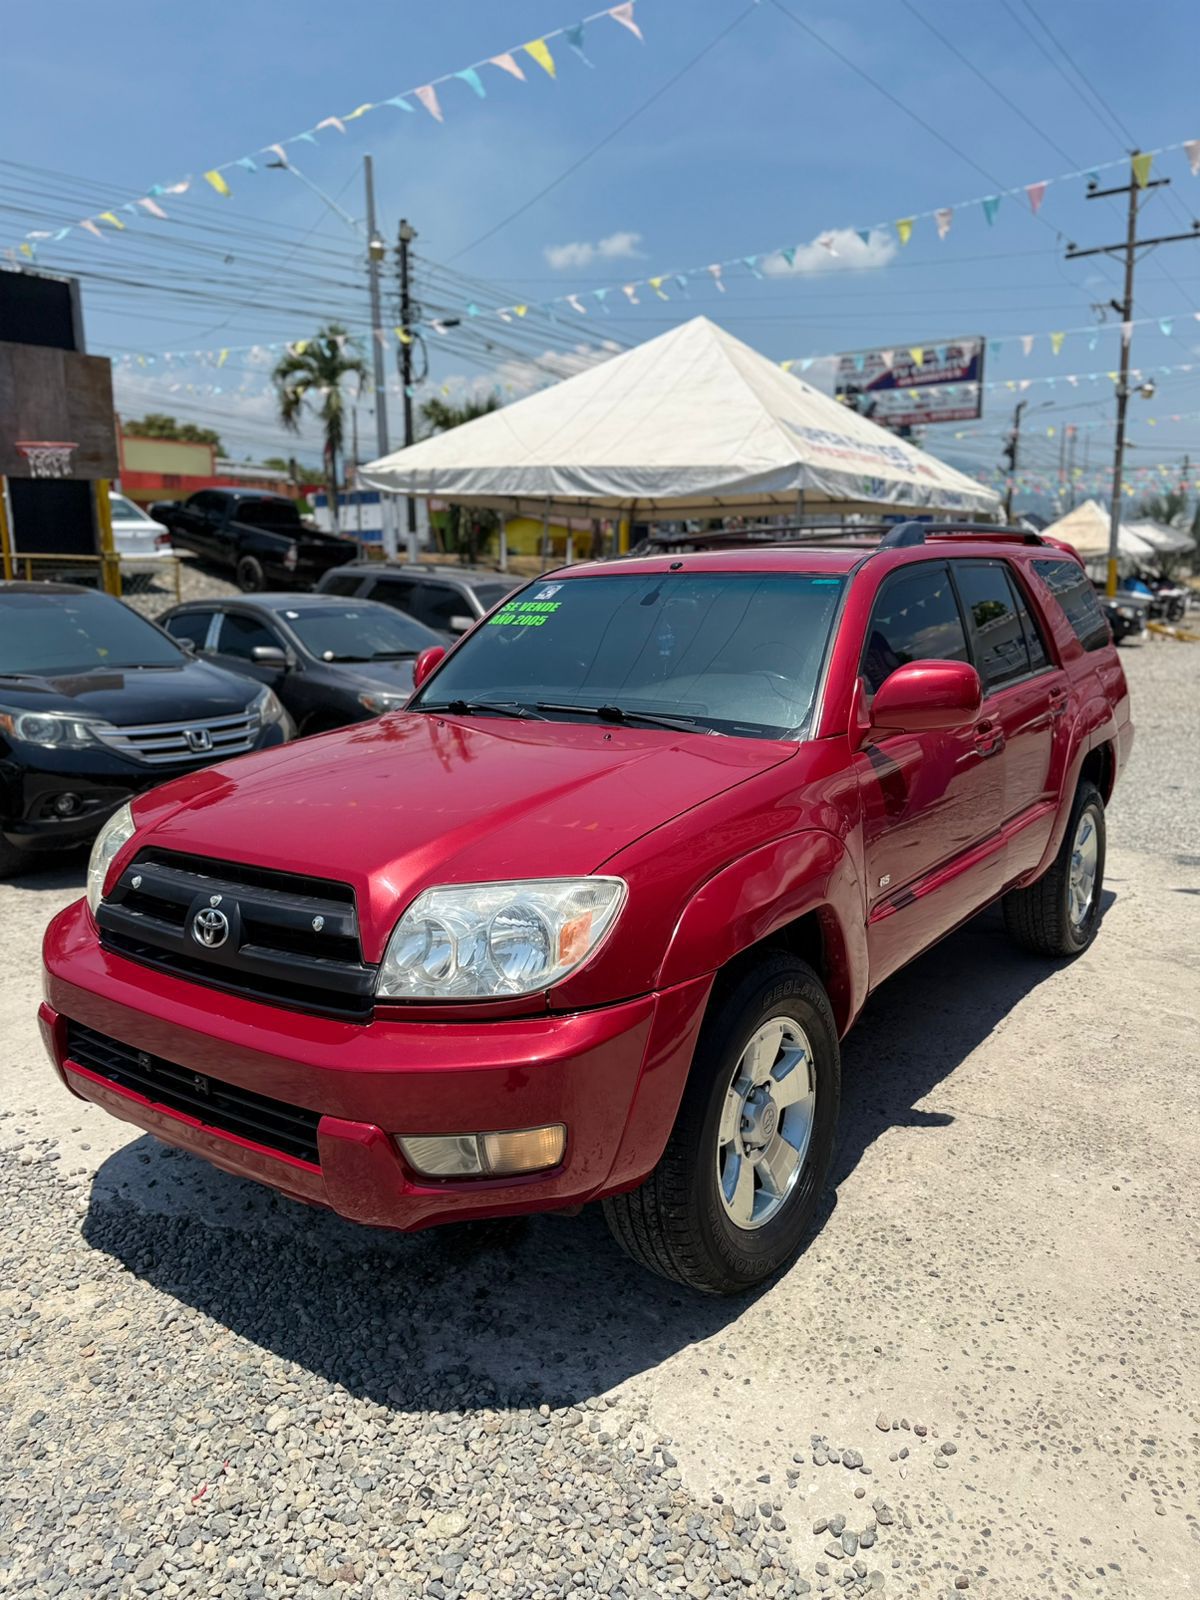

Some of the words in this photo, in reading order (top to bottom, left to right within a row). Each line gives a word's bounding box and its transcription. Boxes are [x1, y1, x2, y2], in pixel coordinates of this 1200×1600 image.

[502, 602, 522, 612] SE
[518, 602, 562, 612] VENDE
[488, 613, 516, 625] AÑO
[511, 615, 549, 626] 2005
